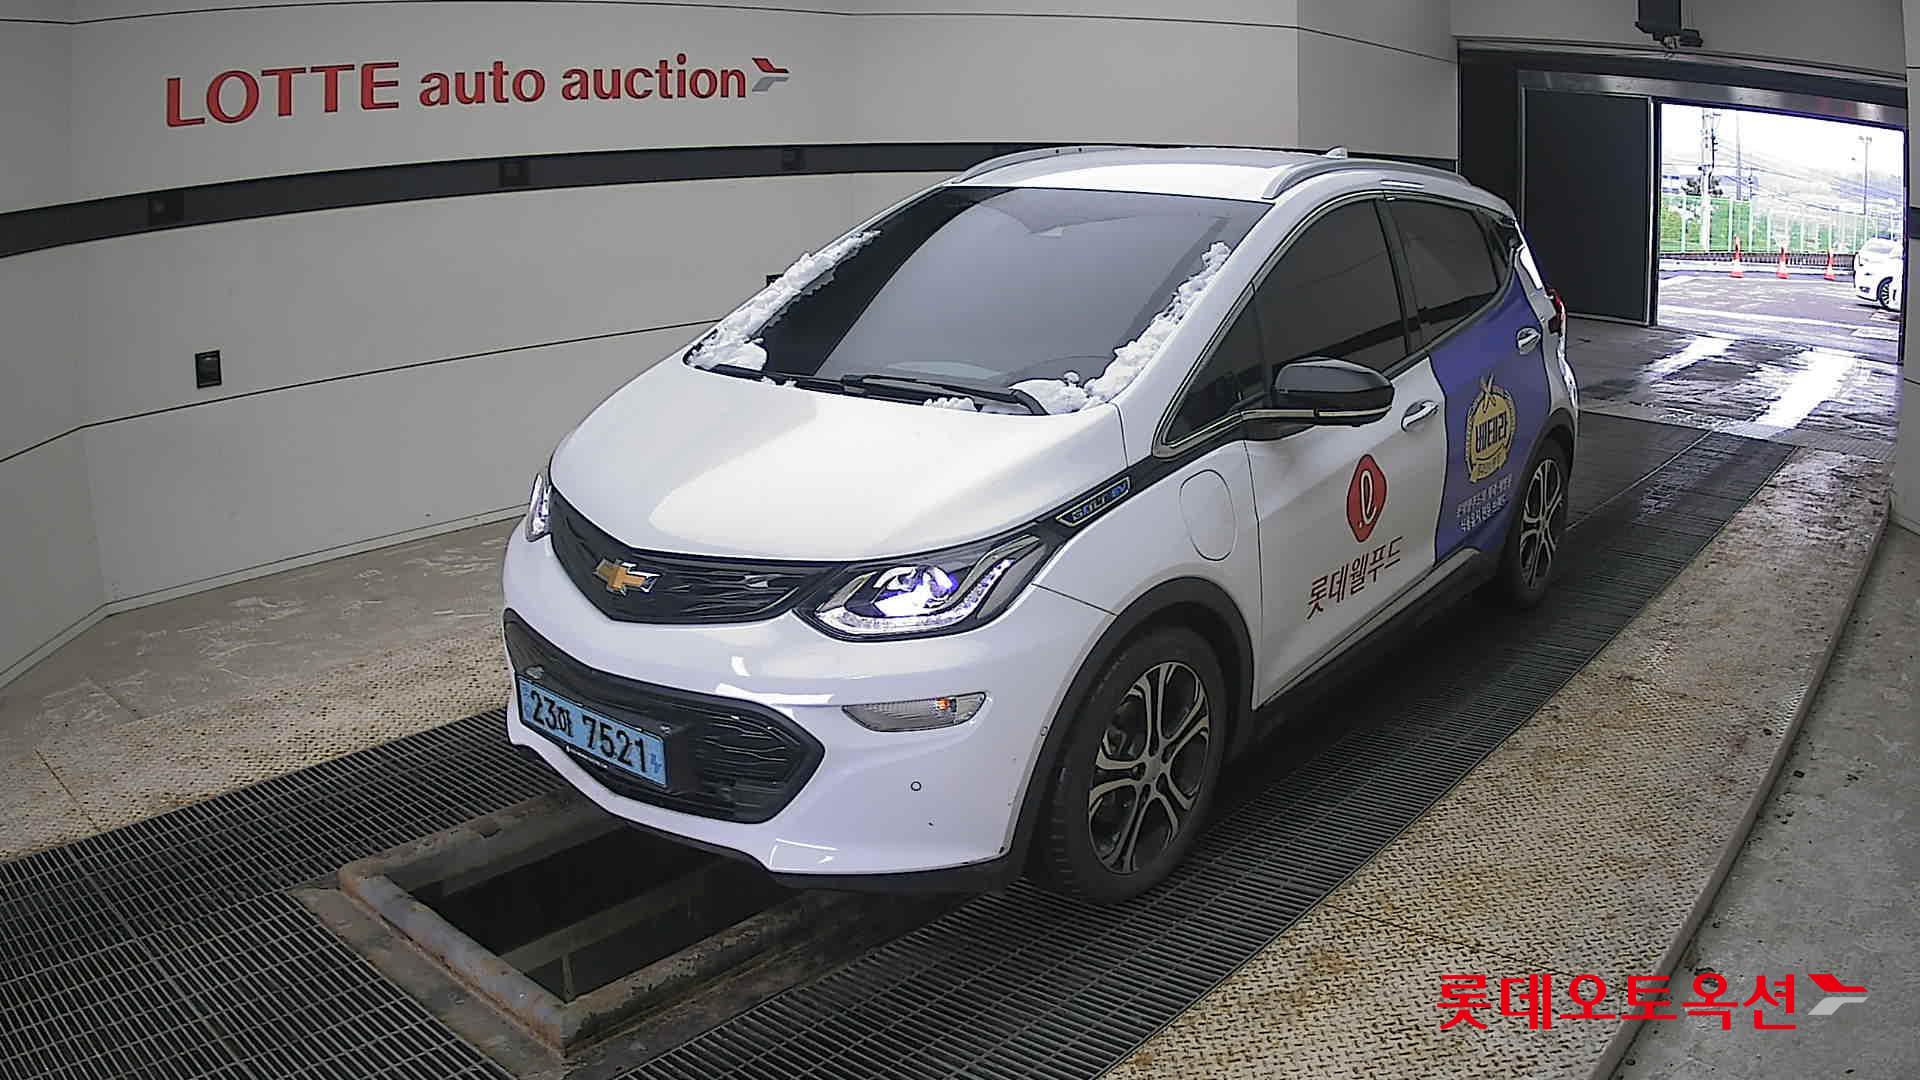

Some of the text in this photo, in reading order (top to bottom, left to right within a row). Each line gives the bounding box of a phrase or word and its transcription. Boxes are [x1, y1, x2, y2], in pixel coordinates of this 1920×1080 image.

[165, 53, 747, 127] LOTTE auto auction
[1307, 536, 1403, 619] 롯데웰푸드
[582, 714, 647, 774] 7521
